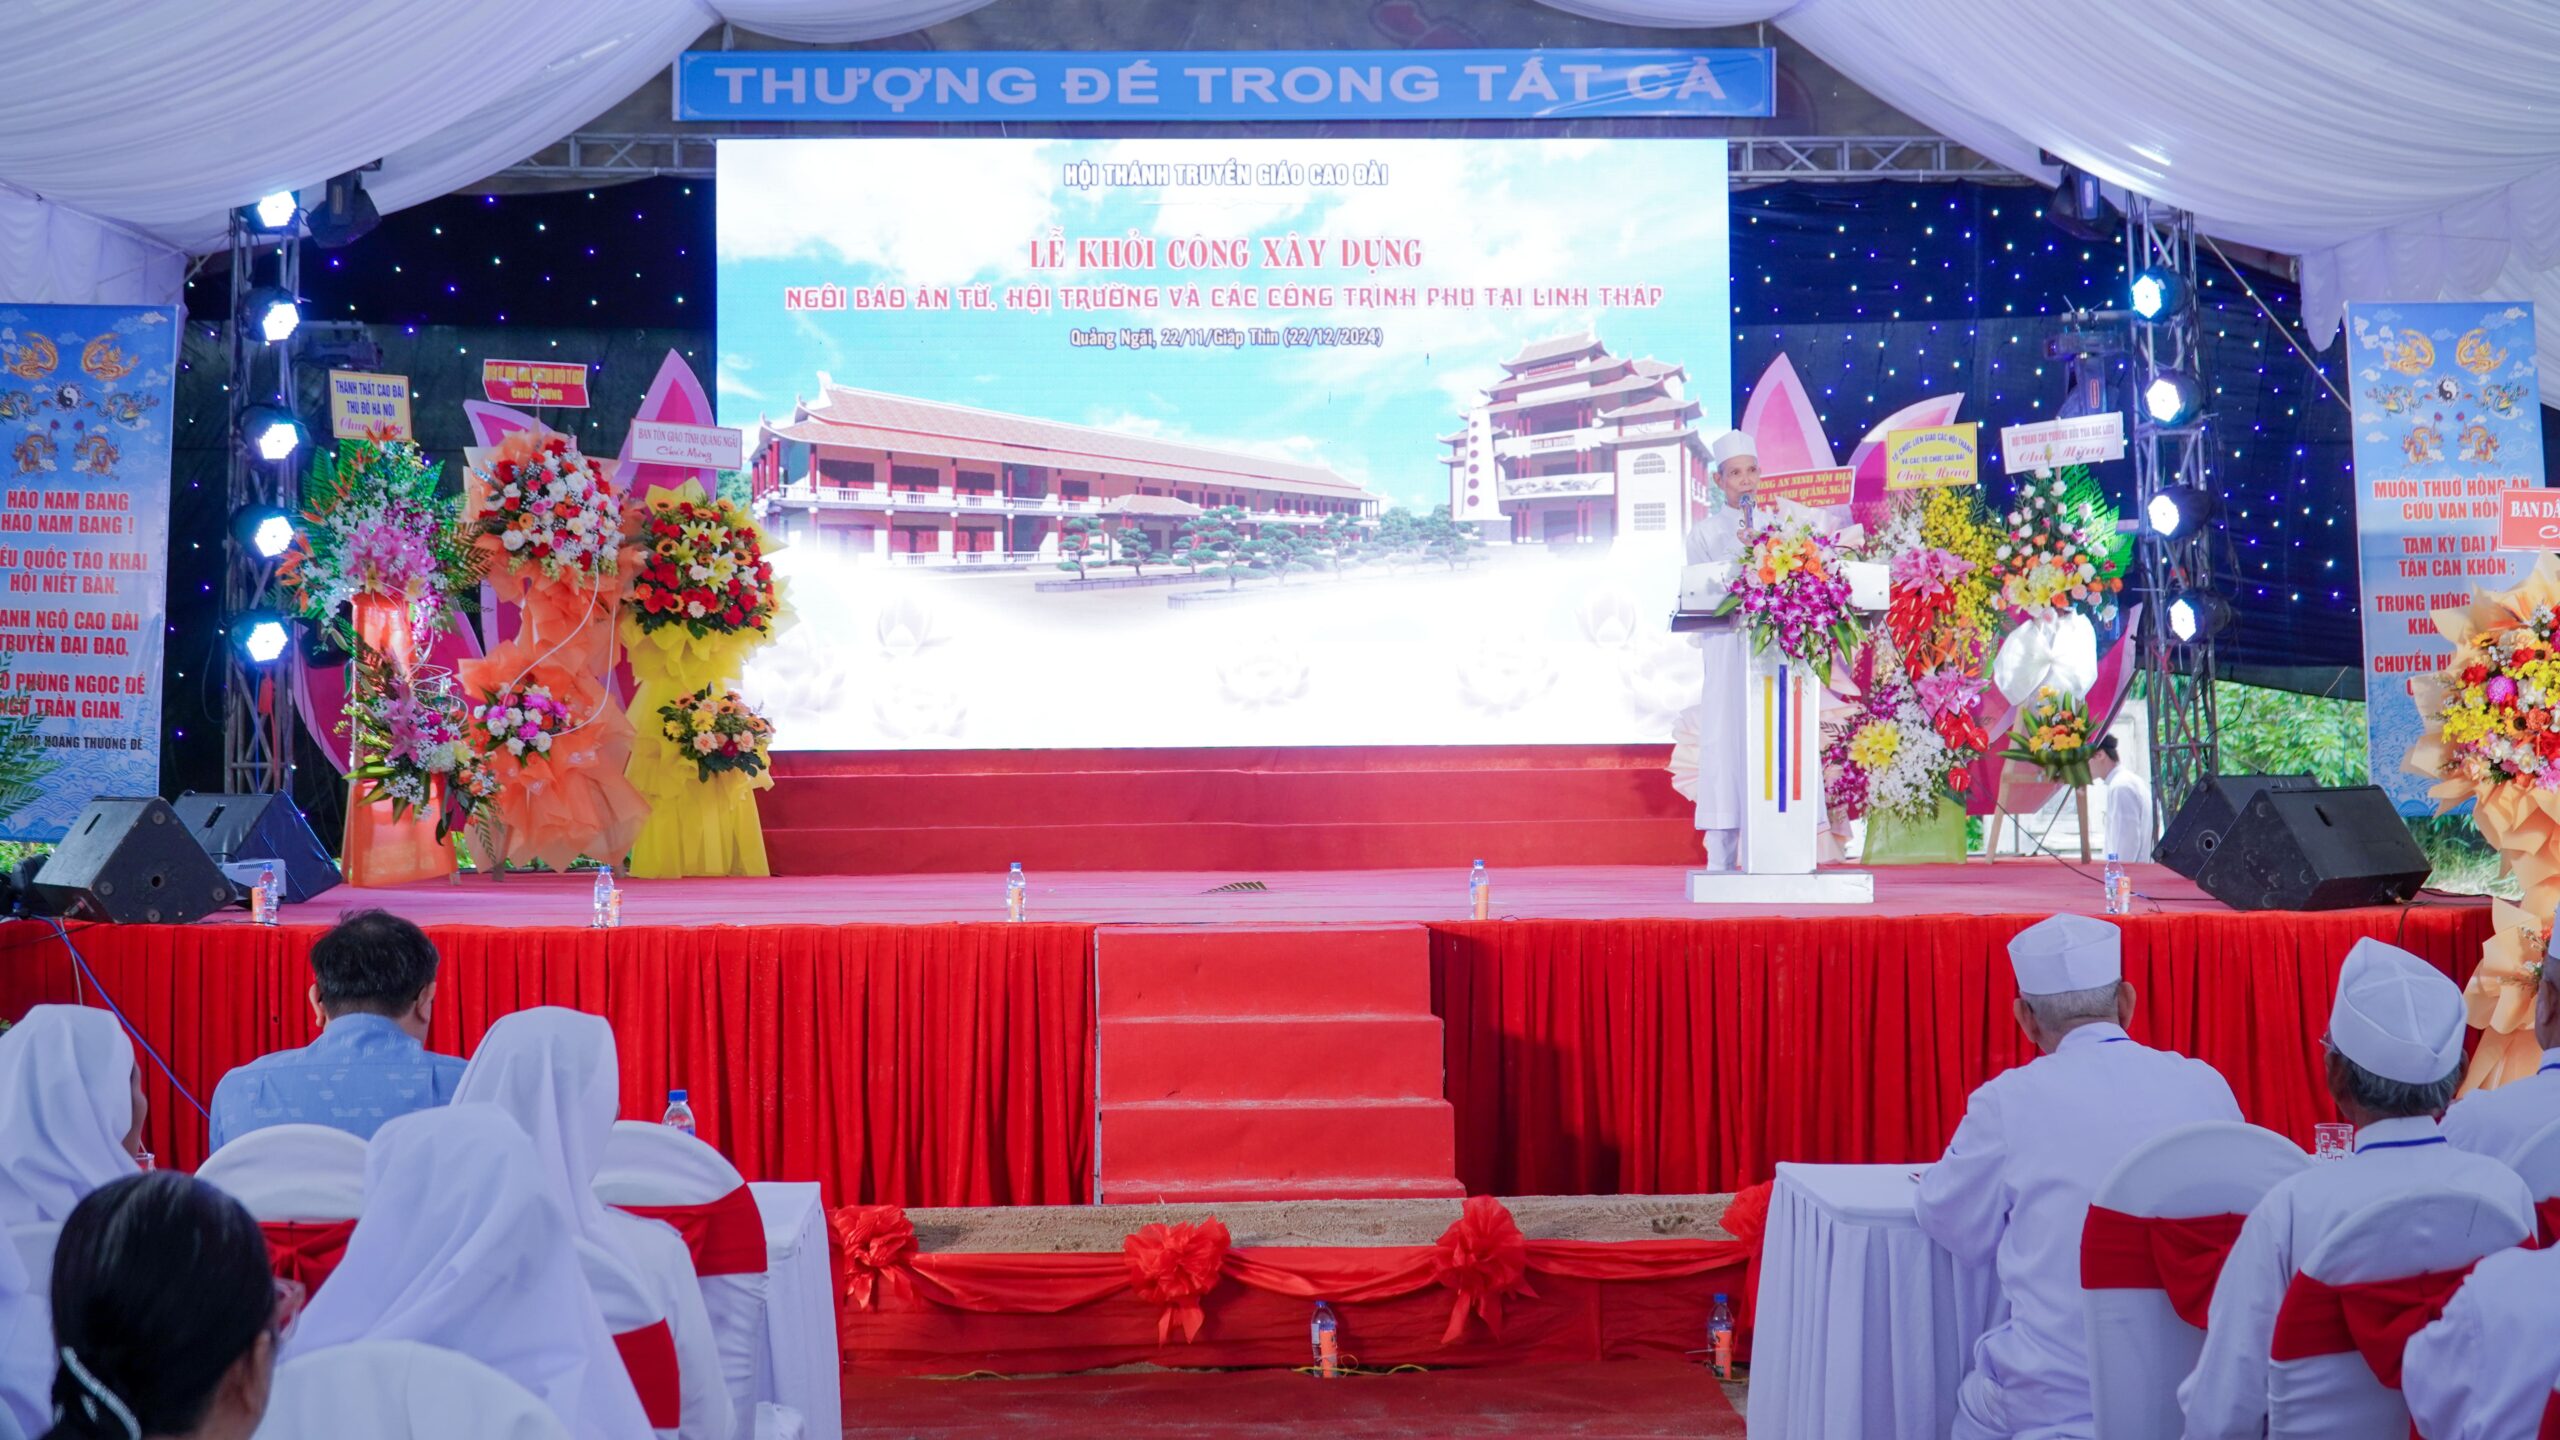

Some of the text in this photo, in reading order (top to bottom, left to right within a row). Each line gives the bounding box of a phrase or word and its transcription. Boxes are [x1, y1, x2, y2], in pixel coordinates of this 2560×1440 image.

[714, 56, 1727, 113] THƯỢNG ĐẾ TRONG TẤT CẢ
[1064, 159, 1098, 190] HỘI
[1103, 160, 1170, 186] THÁNH
[1256, 159, 1304, 186] GIÁO
[1308, 163, 1348, 186] CAO
[1353, 159, 1388, 186] ĐÀI
[1031, 228, 1421, 274] LỄ KHỞI CÔNG XÂY DỰNG
[787, 285, 844, 308] NGÔI
[856, 285, 905, 308] BÁO
[916, 285, 948, 308] ÂN
[1006, 284, 1050, 312] HỘI
[1060, 284, 1158, 309] TRƯỜNG
[1169, 284, 1200, 307] VÀ
[1211, 283, 1257, 307] CÁC
[1268, 283, 1333, 307] CÔNG
[1343, 283, 1416, 308] TRÌNH
[1427, 287, 1474, 311] PHỤ
[1484, 287, 1522, 311] TẠI
[1533, 287, 1588, 306] LINH
[1598, 283, 1662, 306] THÁP
[1070, 327, 1383, 350] Quảng Ngãi, 22/11/Giáp Thìn (22/12/2024)
[377, 384, 391, 397] CAO
[638, 428, 651, 440] BAN
[653, 428, 666, 441] TÔN
[7, 486, 129, 511] HẢO NAM BANG
[2373, 476, 2418, 498] MUÔN
[2403, 501, 2433, 520] CỨU
[2438, 503, 2468, 523] VẠN
[2511, 498, 2560, 518] BAN DÂ
[1, 511, 32, 532] HẢO
[38, 514, 73, 533] NAM
[79, 515, 122, 535] BANG
[24, 544, 67, 570] QUỐC
[109, 552, 148, 571] KHAI
[2403, 536, 2433, 554] TAM
[2461, 536, 2486, 556] ĐẠI
[2398, 558, 2428, 580] TẬN
[2432, 556, 2462, 577] CÀN
[2467, 556, 2507, 575] KHÔN
[10, 571, 37, 596] HỘI
[43, 571, 77, 594] NIẾT
[2375, 594, 2426, 613] TRUNG
[0, 608, 140, 633] ẠNH NGỘ CAO ĐÀI
[2408, 618, 2440, 635] KHA
[61, 636, 88, 658] ĐẠI
[16, 671, 70, 693] PHÙNG
[75, 674, 120, 697] NGỌC
[125, 672, 146, 695] ĐẾ
[35, 693, 76, 718] TRẦN
